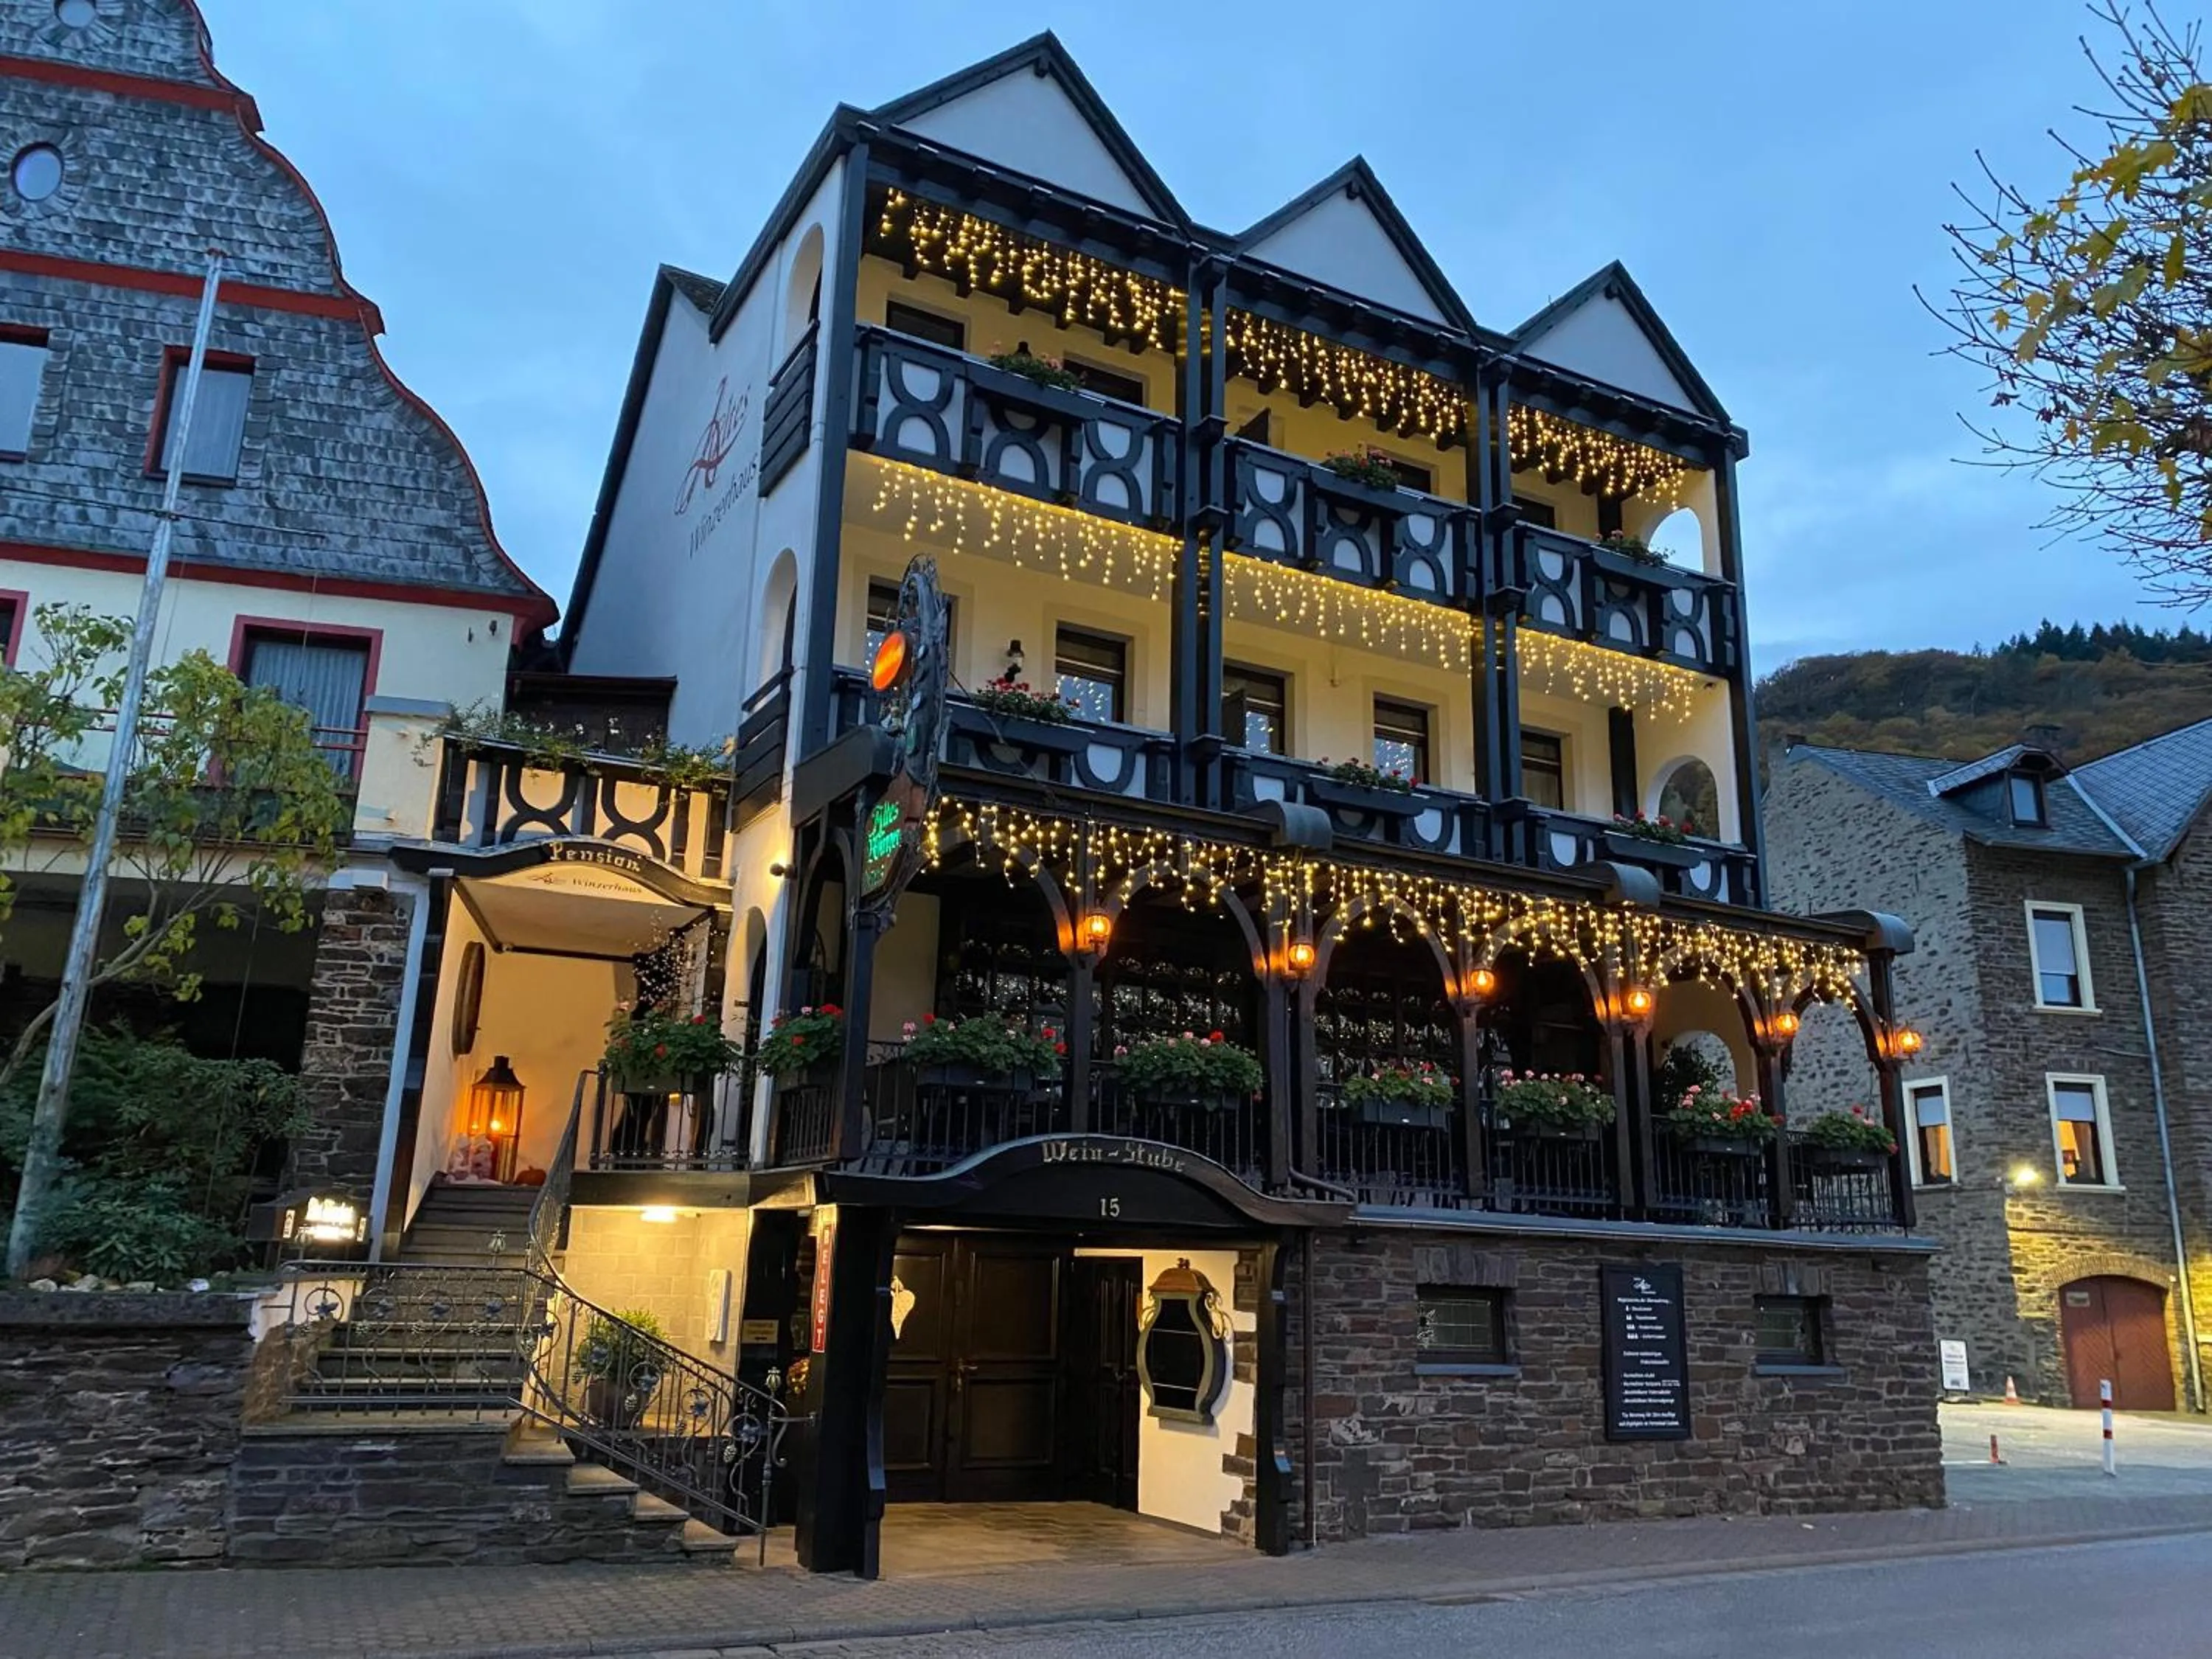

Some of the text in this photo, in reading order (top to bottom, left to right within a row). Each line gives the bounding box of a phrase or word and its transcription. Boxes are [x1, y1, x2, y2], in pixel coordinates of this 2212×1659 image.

[549, 841, 640, 872] Pension
[573, 877, 642, 893] Winzerhaus
[1100, 1197, 1120, 1217] 15
[816, 1229, 830, 1344] BELEGT
